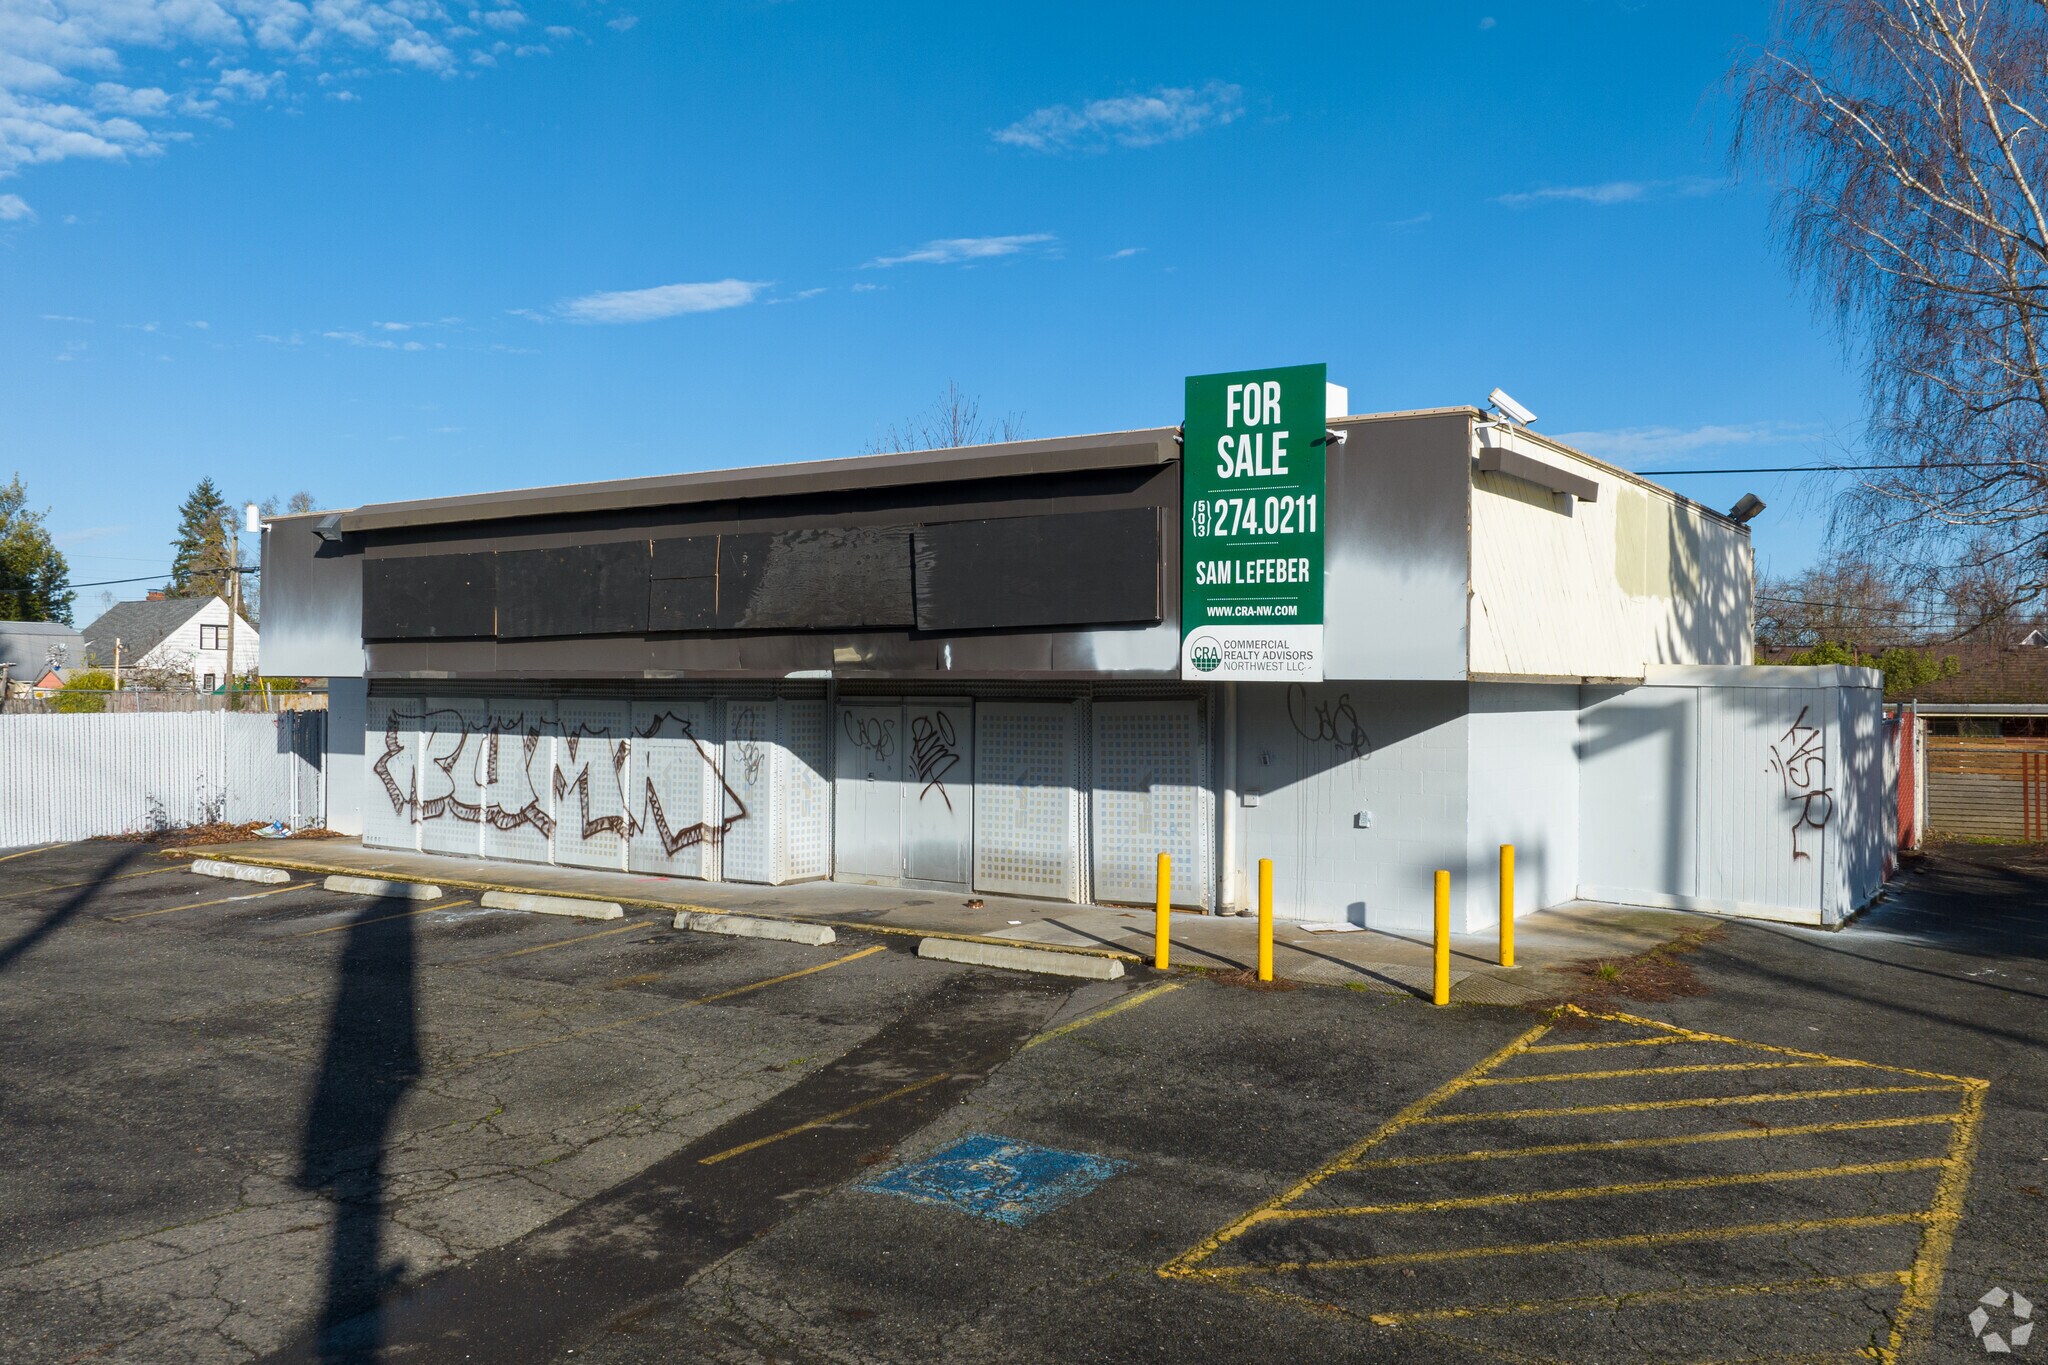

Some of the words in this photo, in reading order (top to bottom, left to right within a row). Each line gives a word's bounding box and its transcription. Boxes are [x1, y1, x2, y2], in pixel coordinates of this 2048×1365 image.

[1226, 381, 1281, 428] FOR
[1217, 431, 1289, 479] SALE
[1214, 494, 1316, 537] 274.0211
[1196, 560, 1231, 585] SAM
[1206, 605, 1298, 617] WWW.CRA-NW.COM
[1223, 640, 1290, 649] COMMERCIAL
[1194, 646, 1219, 660] CRA
[1223, 651, 1260, 660] REALTY
[1262, 651, 1314, 660] ADVISORS
[1223, 661, 1284, 671] NORTHWEST
[1286, 661, 1305, 671] LLC
